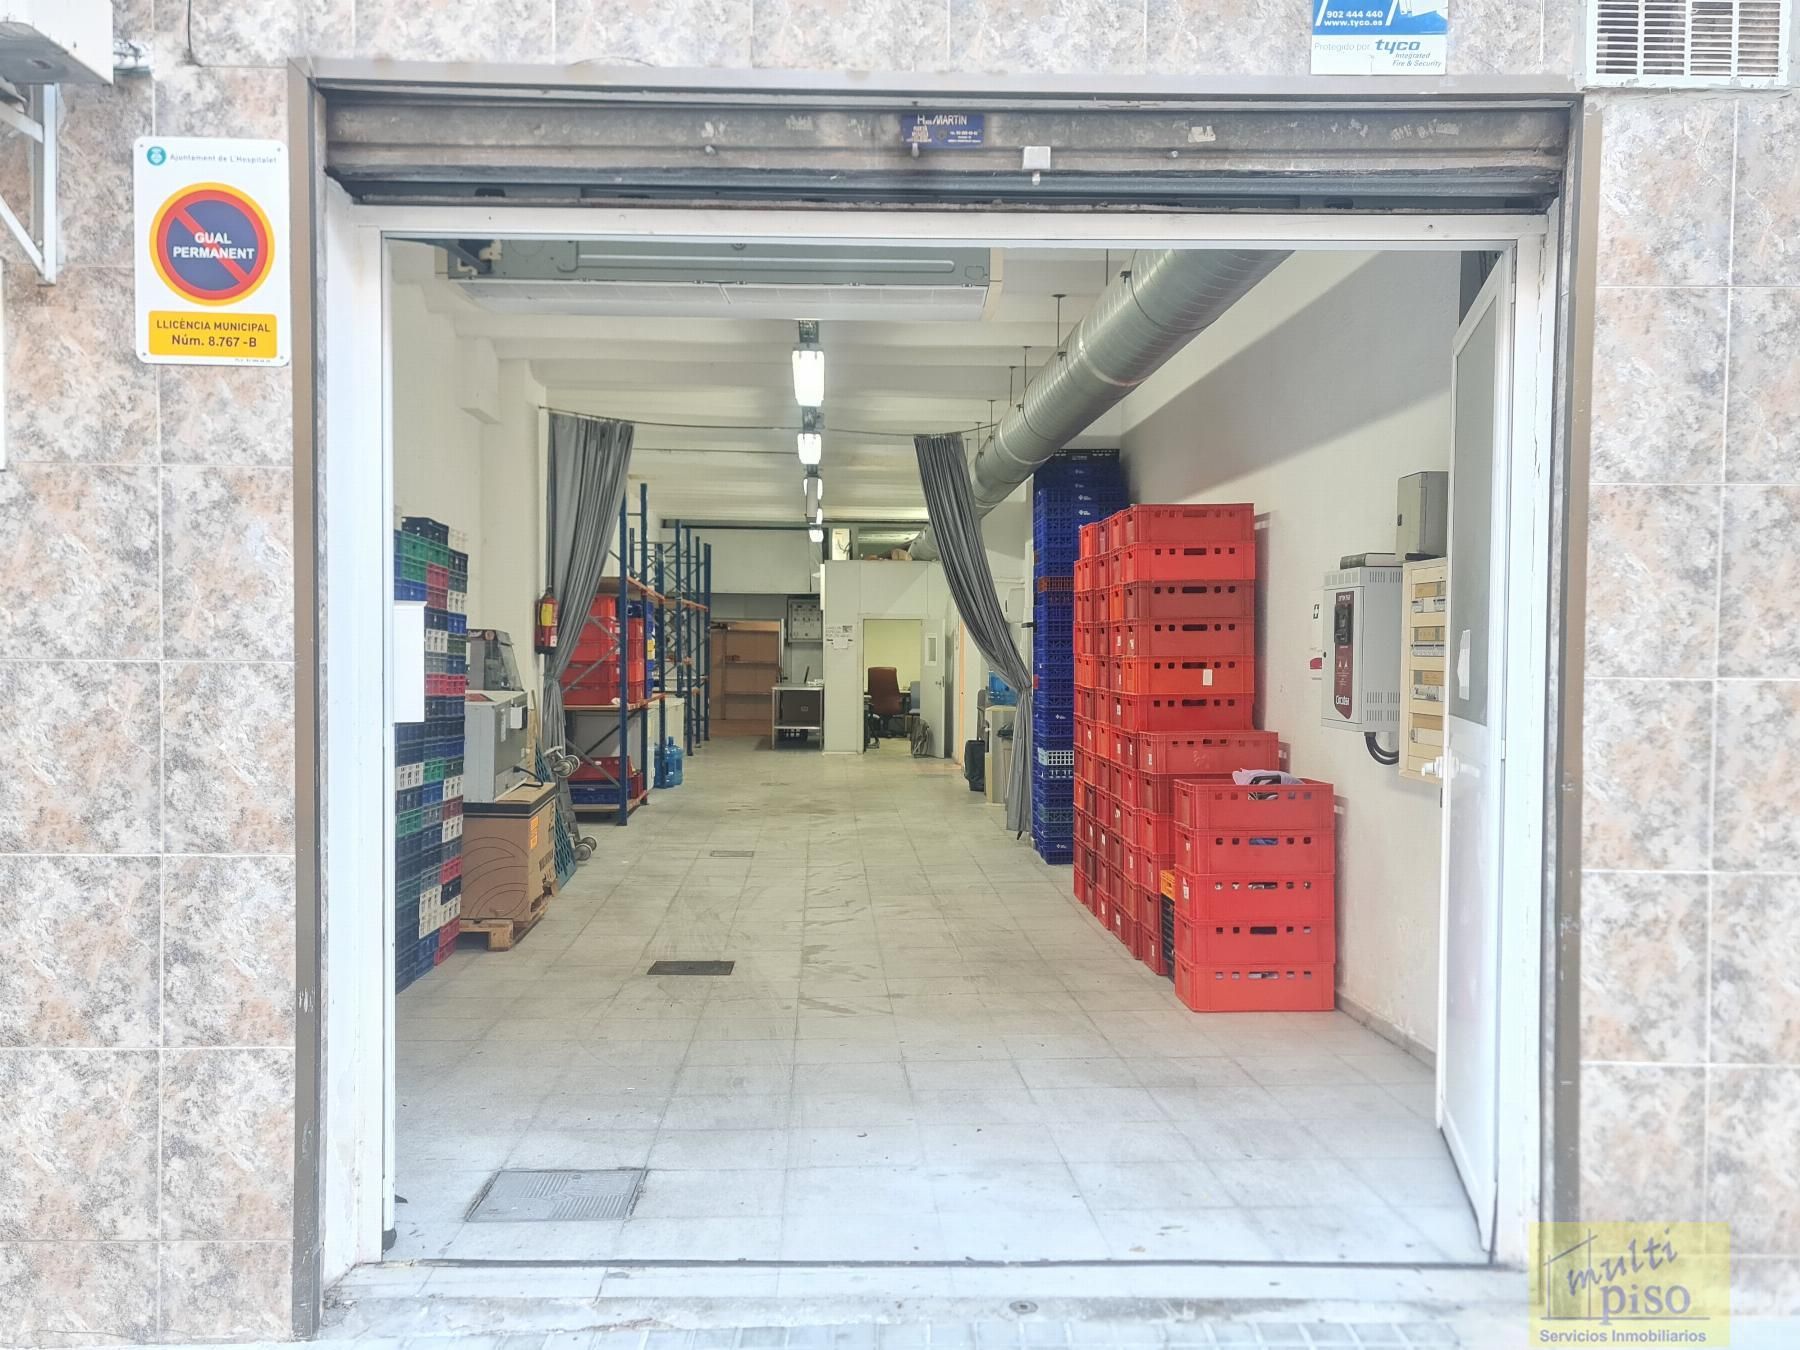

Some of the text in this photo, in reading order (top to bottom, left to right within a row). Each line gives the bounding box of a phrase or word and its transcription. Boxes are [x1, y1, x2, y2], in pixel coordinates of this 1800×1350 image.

[1326, 10, 1383, 18] 902 444 440
[1324, 19, 1383, 27] www.tyco.es
[1314, 39, 1421, 54] Protegido por tyco
[1395, 52, 1431, 60] Integrated
[1413, 60, 1442, 68] Security
[170, 153, 216, 162] Ajuntament
[218, 154, 227, 162] de
[194, 232, 232, 244] GUAL
[172, 246, 255, 260] PERMANENT
[213, 321, 271, 333] MUNICIPAL
[171, 334, 205, 346] Núm.
[208, 336, 240, 347] 8.767
